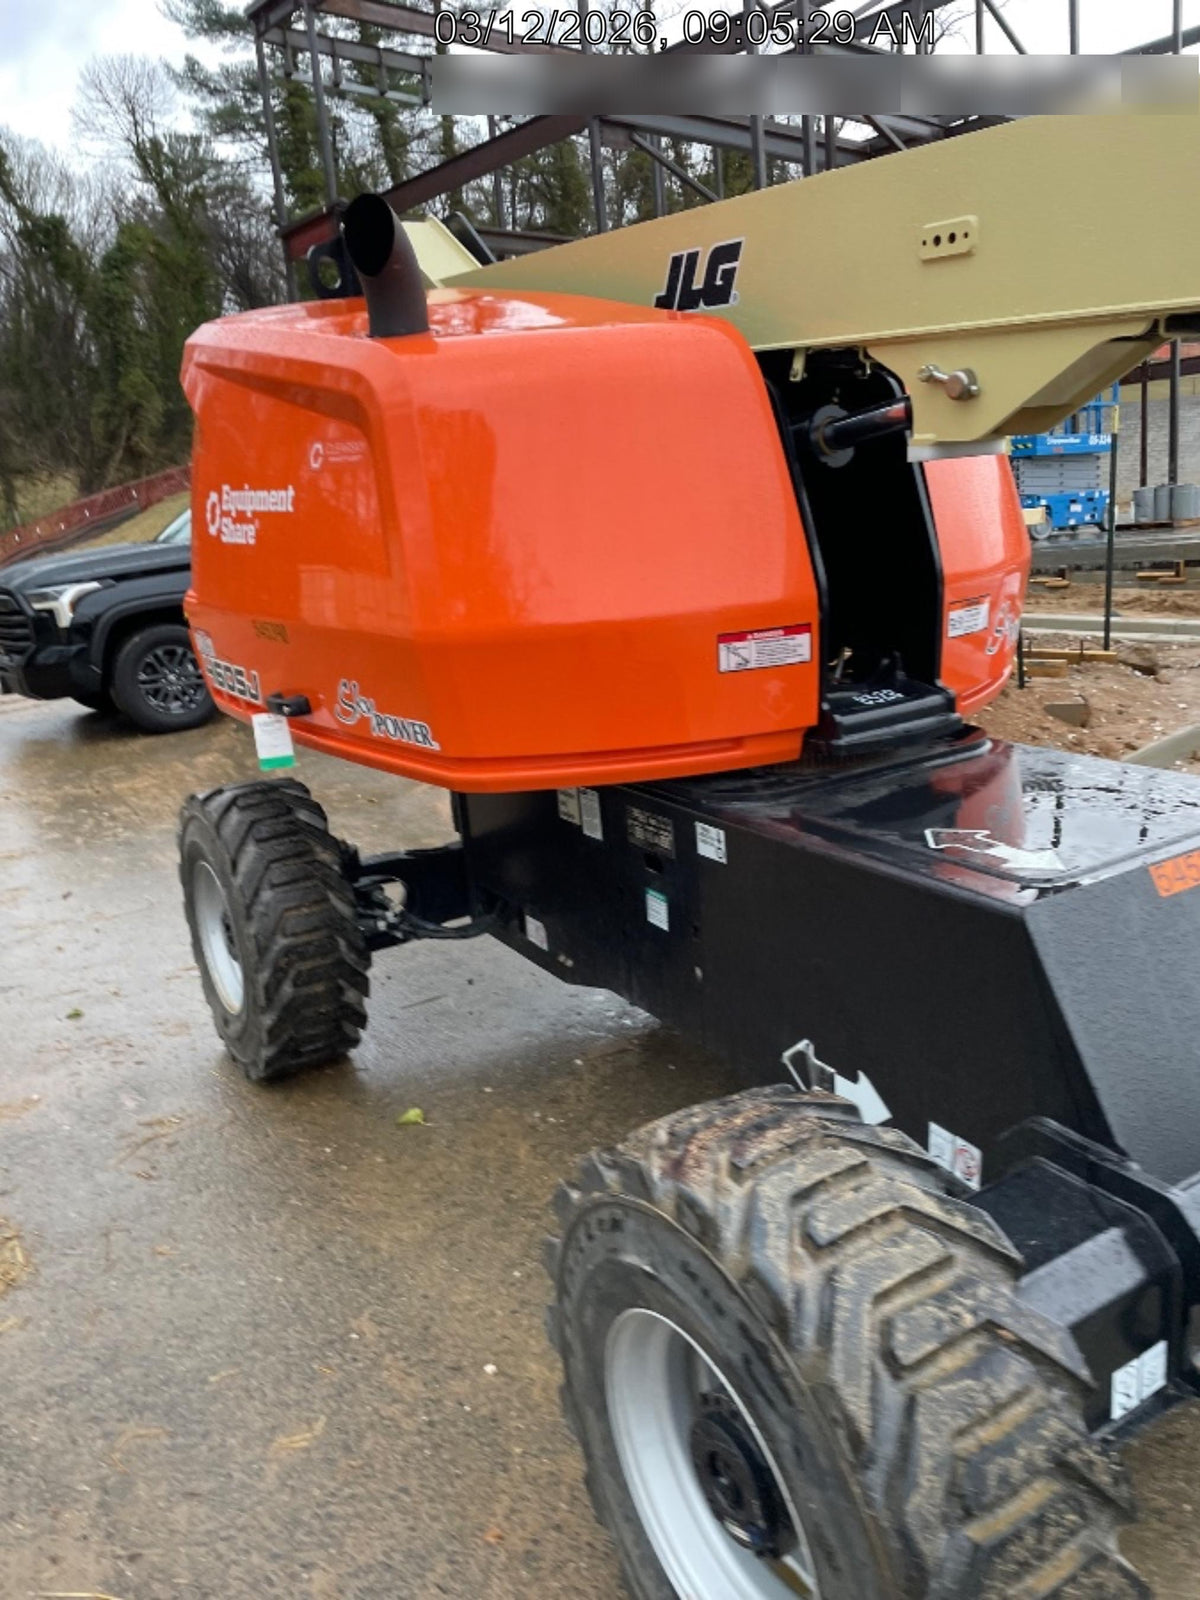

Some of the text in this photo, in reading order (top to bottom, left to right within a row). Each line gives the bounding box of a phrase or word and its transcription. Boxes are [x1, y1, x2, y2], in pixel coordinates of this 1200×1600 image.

[654, 237, 744, 311] JLG
[221, 483, 295, 518] Equipment
[221, 517, 257, 544] Share
[371, 712, 441, 751] POWER
